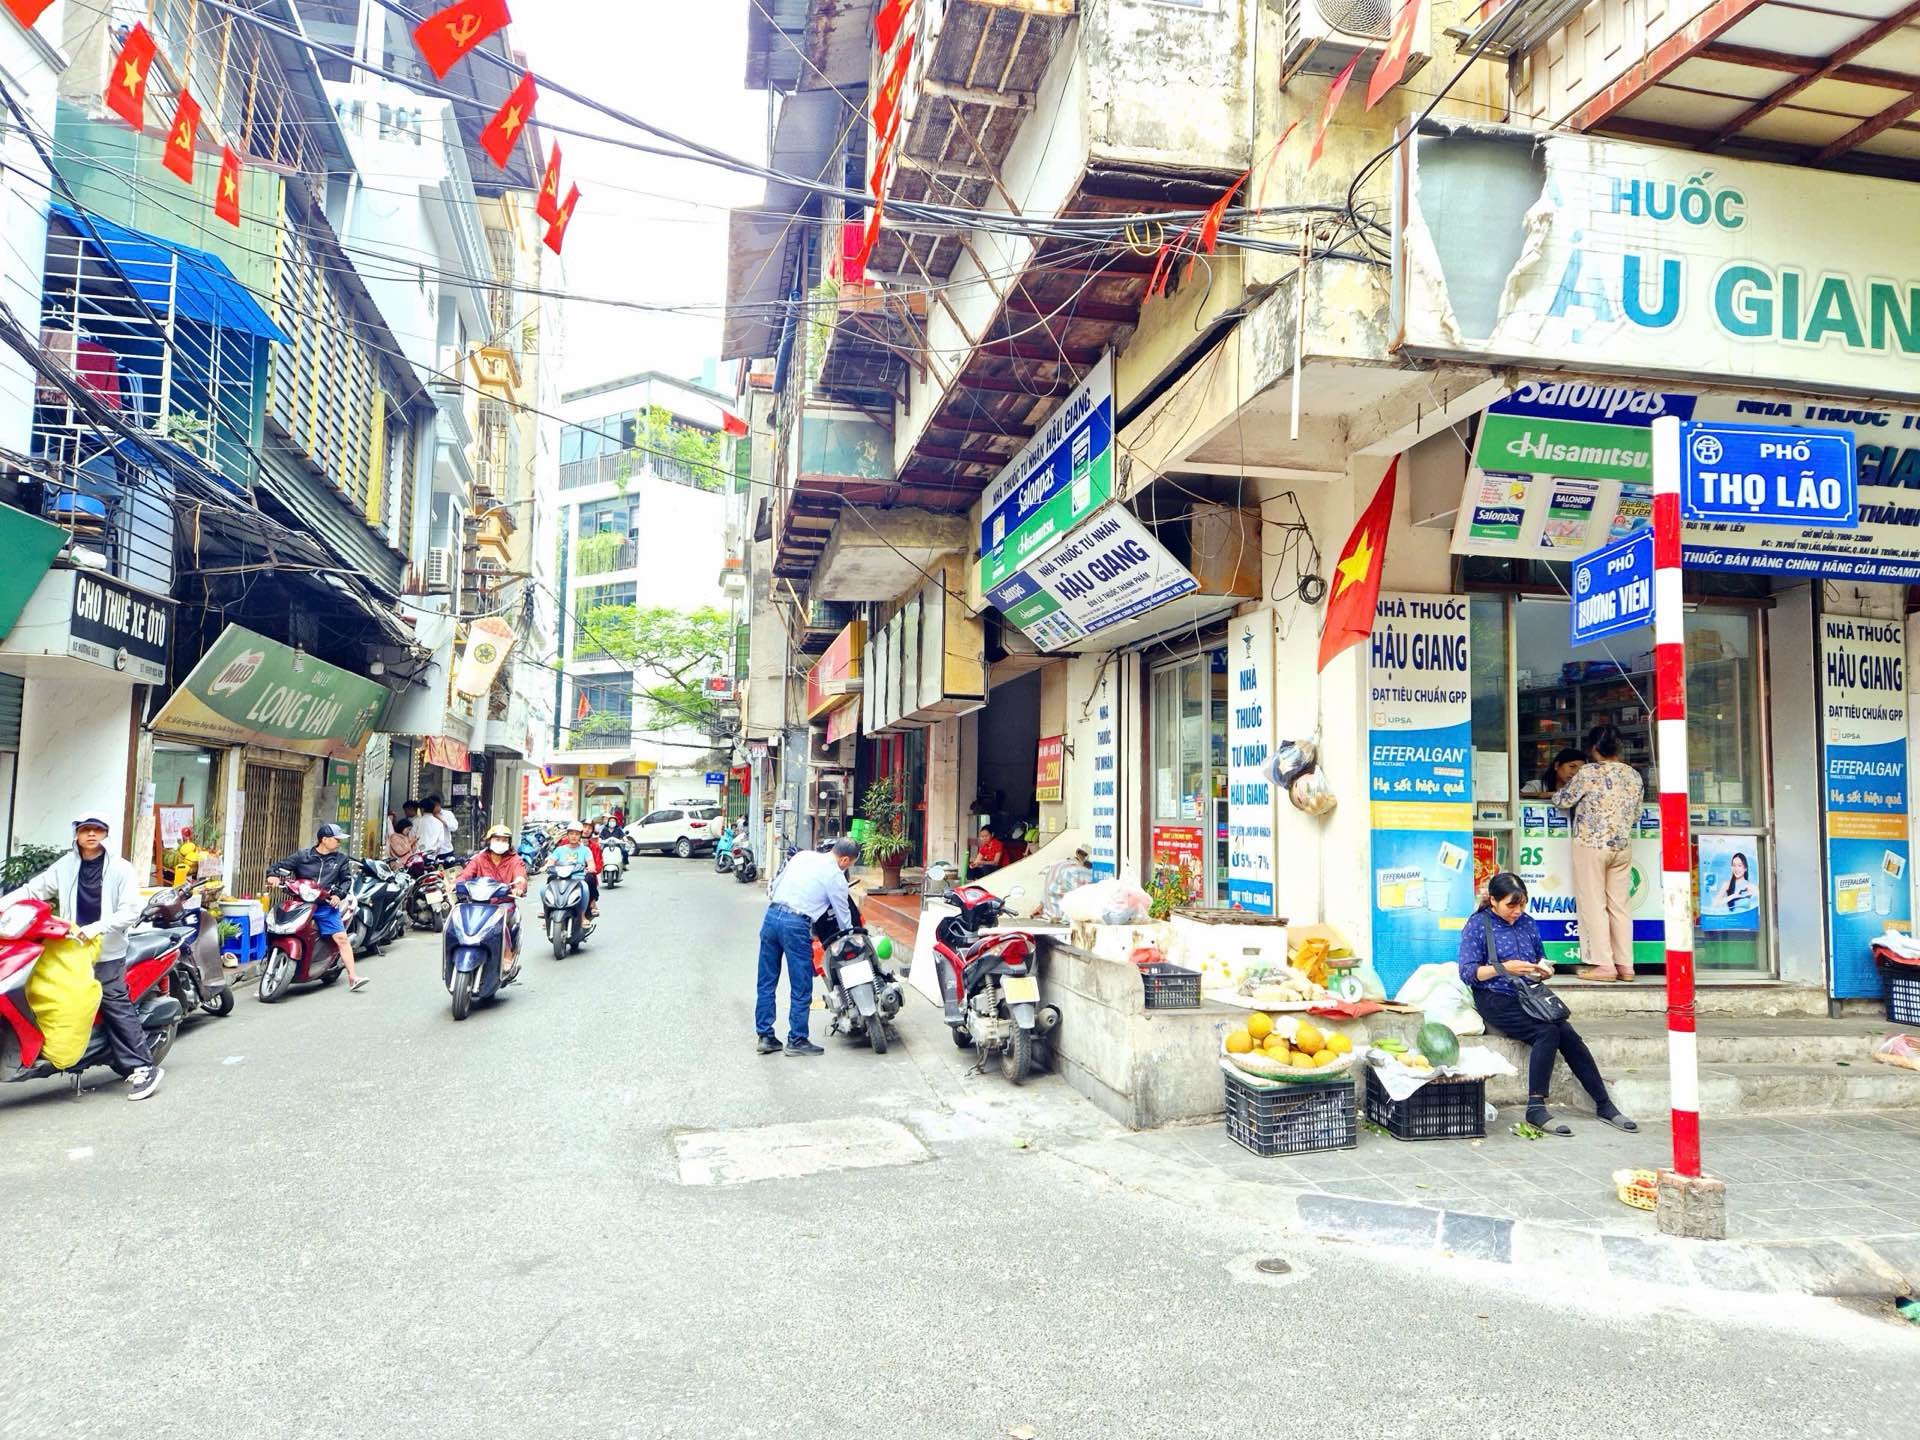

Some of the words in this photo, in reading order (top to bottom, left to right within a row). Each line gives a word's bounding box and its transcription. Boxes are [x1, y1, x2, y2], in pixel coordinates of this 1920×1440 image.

[1517, 382, 1665, 418] Salonpas
[1003, 467, 1021, 493] THUỐC
[1046, 416, 1063, 451] HẬU
[1064, 387, 1091, 433] GIANG
[1506, 431, 1649, 469] Hisamitsu
[1760, 438, 1812, 462] PHỐ
[1018, 462, 1055, 517] Salonpas
[1555, 494, 1592, 504] SALONSIP
[1699, 472, 1766, 512] THỌ
[1776, 470, 1841, 510] LÃO
[1477, 508, 1520, 523] Salonpas
[1038, 560, 1058, 578] NHÀ
[1053, 543, 1084, 568] THUỐC
[1079, 533, 1095, 550] TƯ
[1091, 518, 1122, 542] NHÂN
[1607, 545, 1635, 576] PHỐ
[1055, 569, 1095, 601] HẬU
[1088, 539, 1151, 582] GIANG
[1683, 550, 1723, 565] THUỐC
[1724, 552, 1750, 566] BÁN
[1751, 555, 1783, 569] HÀNG
[1785, 557, 1820, 571] CHÍNH
[1822, 561, 1853, 574] HÃNG
[1854, 560, 1876, 575] CỦA
[1375, 598, 1407, 618] NHÀ
[1410, 598, 1466, 620] THUỐC
[1618, 574, 1650, 616] VIÊN
[76, 577, 102, 622] CHO
[104, 588, 131, 634] THUÊ
[130, 601, 147, 640] XE
[146, 602, 166, 648] ÔTÔ
[1827, 621, 1855, 640] NHÀ
[1857, 622, 1901, 644] THUỐC
[1372, 624, 1408, 680] HẬU
[1412, 633, 1467, 671] GIANG
[218, 661, 256, 684] MILO
[1240, 663, 1257, 691] NHÀ
[1827, 645, 1856, 699] HẬU
[1860, 655, 1903, 691] GIANG
[246, 682, 309, 729] LONG
[300, 692, 344, 736] VÂN
[1372, 687, 1391, 704] ĐẠT
[1392, 686, 1413, 702] TIÊU
[1414, 686, 1447, 703] CHUẨN
[1448, 690, 1467, 704] GPP
[1236, 698, 1262, 730] THUỐC
[1829, 705, 1843, 720] ĐẠT
[1844, 704, 1861, 719] TIÊU
[1862, 704, 1888, 721] CHUẨN
[1888, 709, 1904, 721] GPP
[1232, 744, 1243, 768] TƯ
[1244, 740, 1267, 767] NHÂN
[1373, 745, 1464, 763] EFFERALGAN
[1830, 759, 1901, 777] EFFERALGAN
[1231, 780, 1245, 811] HẬU
[1246, 783, 1269, 806] GIANG
[1373, 777, 1390, 794] Hạ
[1393, 778, 1412, 792] sốt
[1415, 778, 1440, 794] hiệu
[1443, 779, 1465, 797] quả
[1831, 789, 1844, 805] Hạ
[1846, 790, 1862, 804] sốt
[1864, 790, 1883, 806] hiệu
[1885, 792, 1903, 809] quả
[1257, 855, 1270, 870] 7%
[1382, 871, 1421, 881] EFFERALGAN
[1840, 877, 1870, 888] EFFERALGAN
